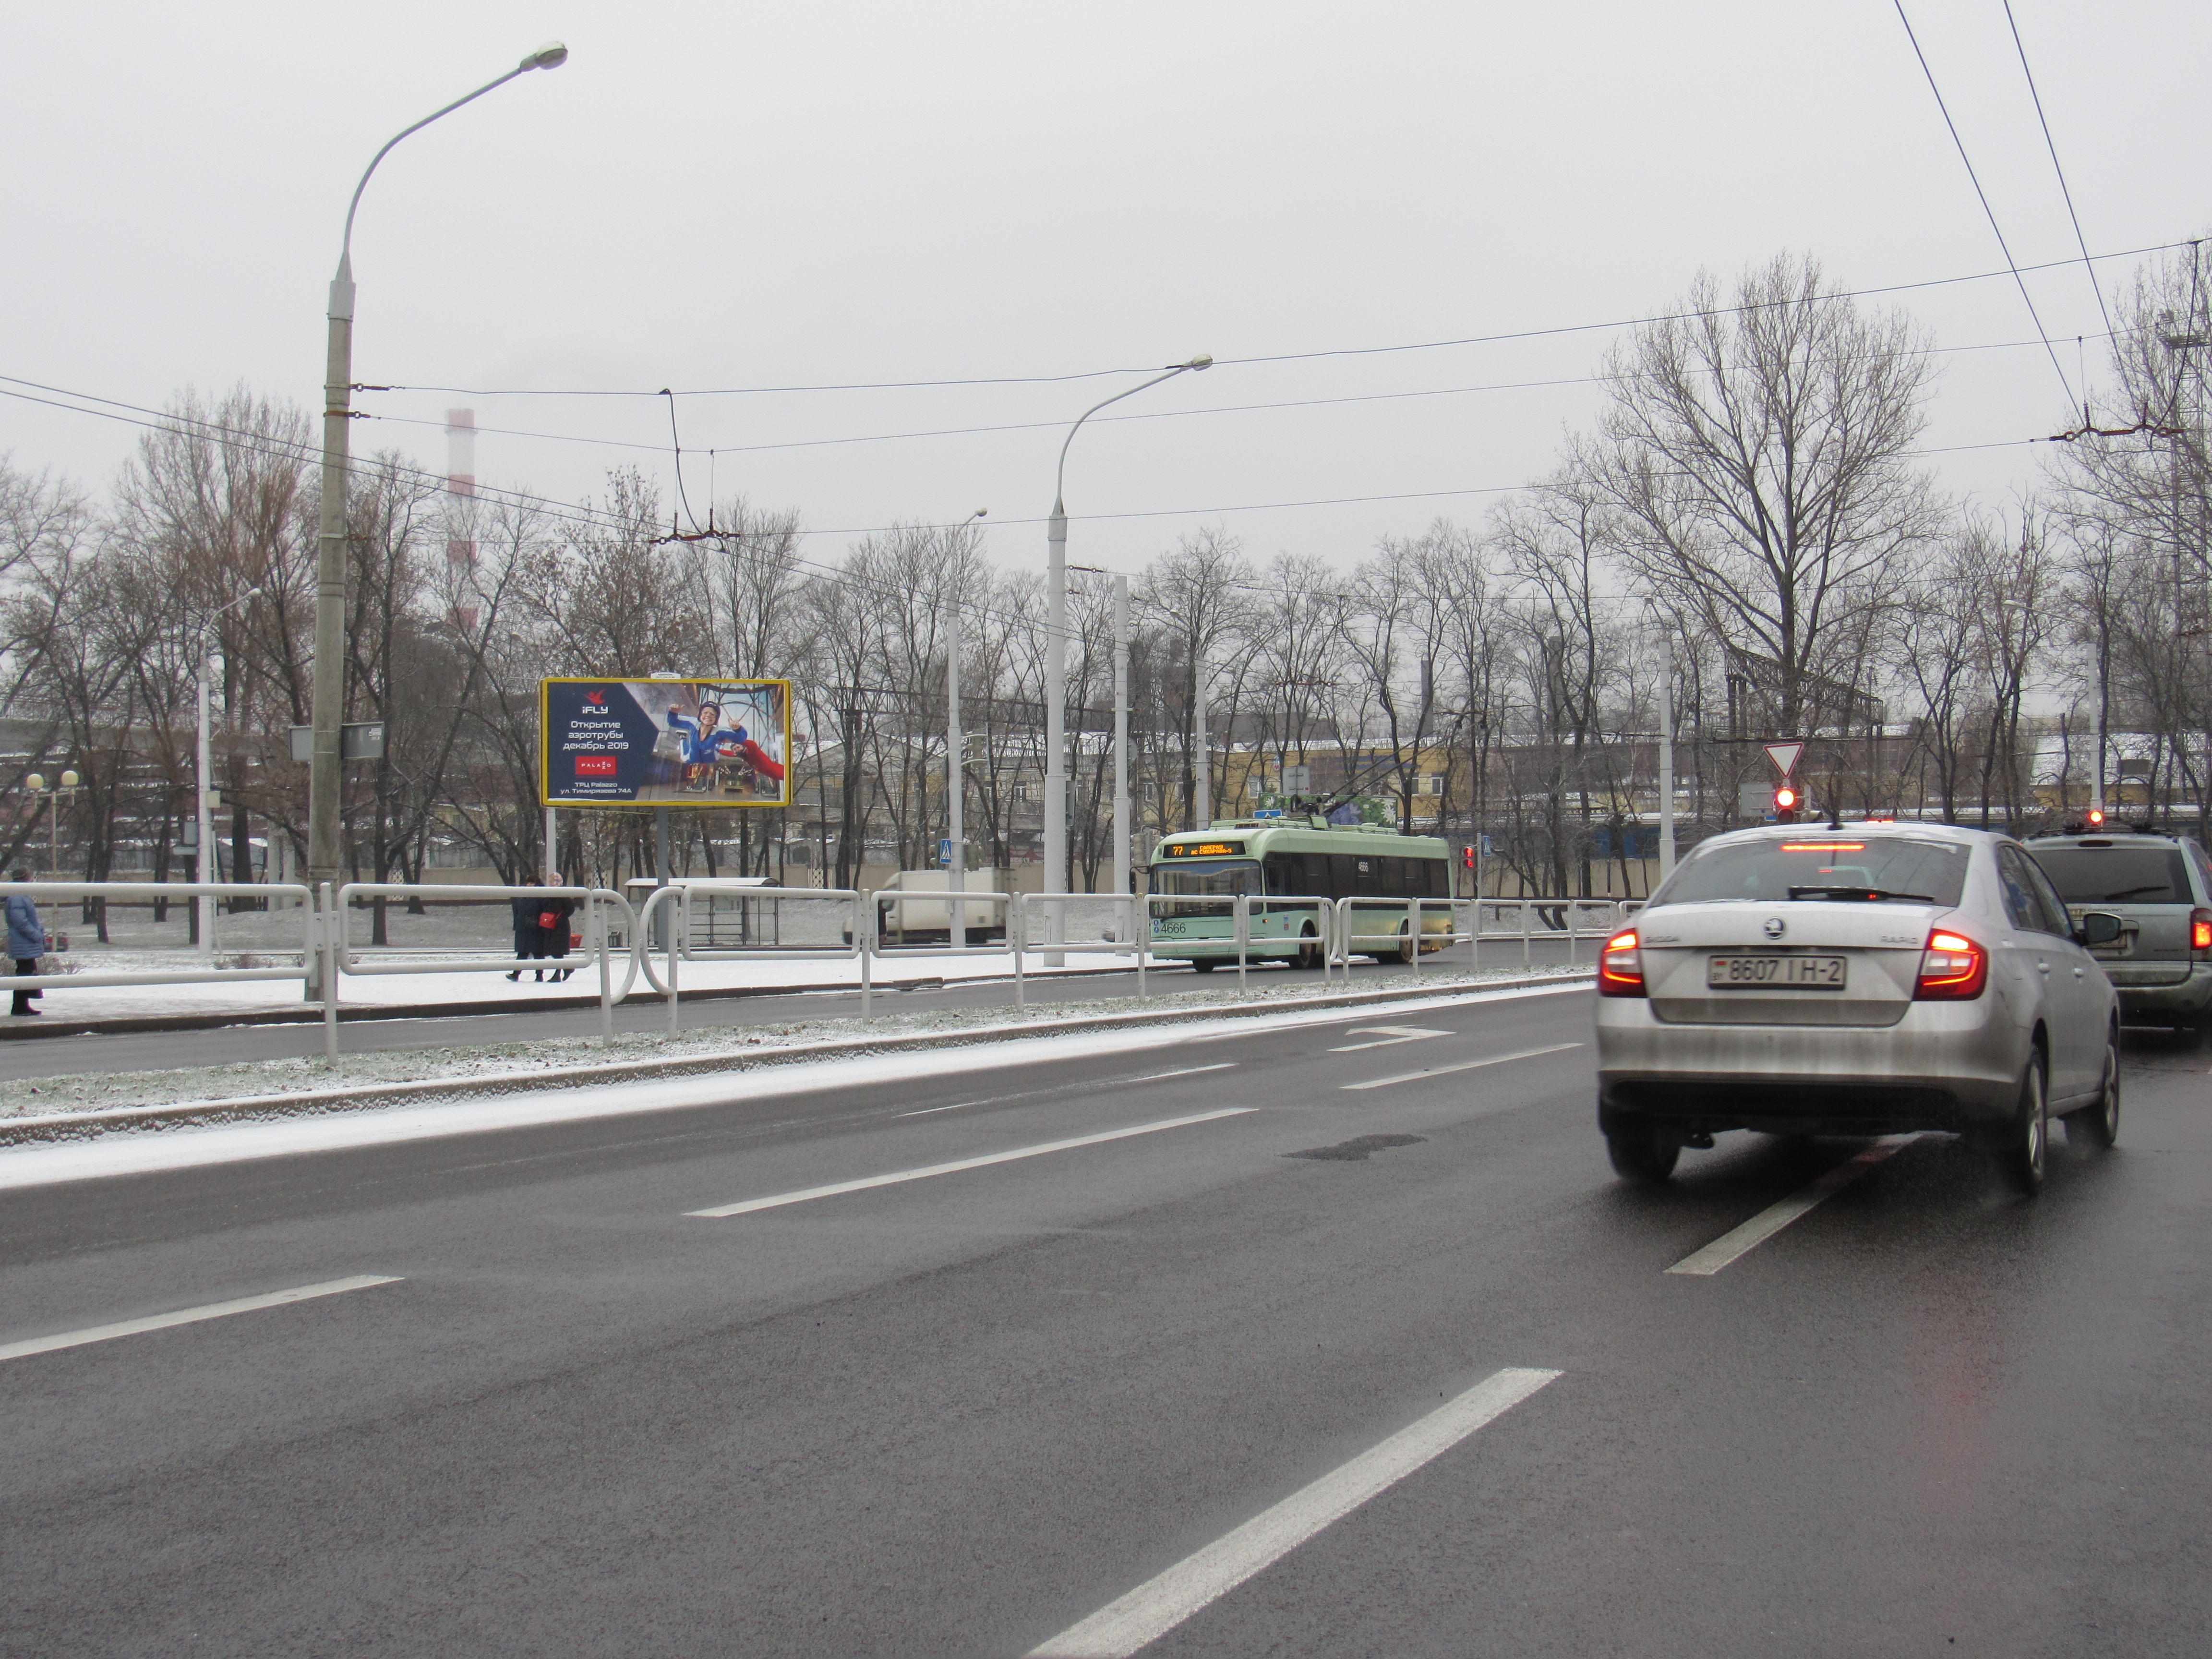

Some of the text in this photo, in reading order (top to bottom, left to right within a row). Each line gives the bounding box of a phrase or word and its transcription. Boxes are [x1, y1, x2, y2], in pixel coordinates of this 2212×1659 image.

[582, 706, 609, 714] iFLY
[571, 721, 621, 730] Открытие
[568, 730, 624, 740] аэротрубы
[563, 741, 605, 751] декабрь
[1173, 846, 1184, 856] 77
[1358, 862, 1369, 872] 4666
[1161, 923, 1186, 934] 4666
[1730, 960, 1779, 980] 8607
